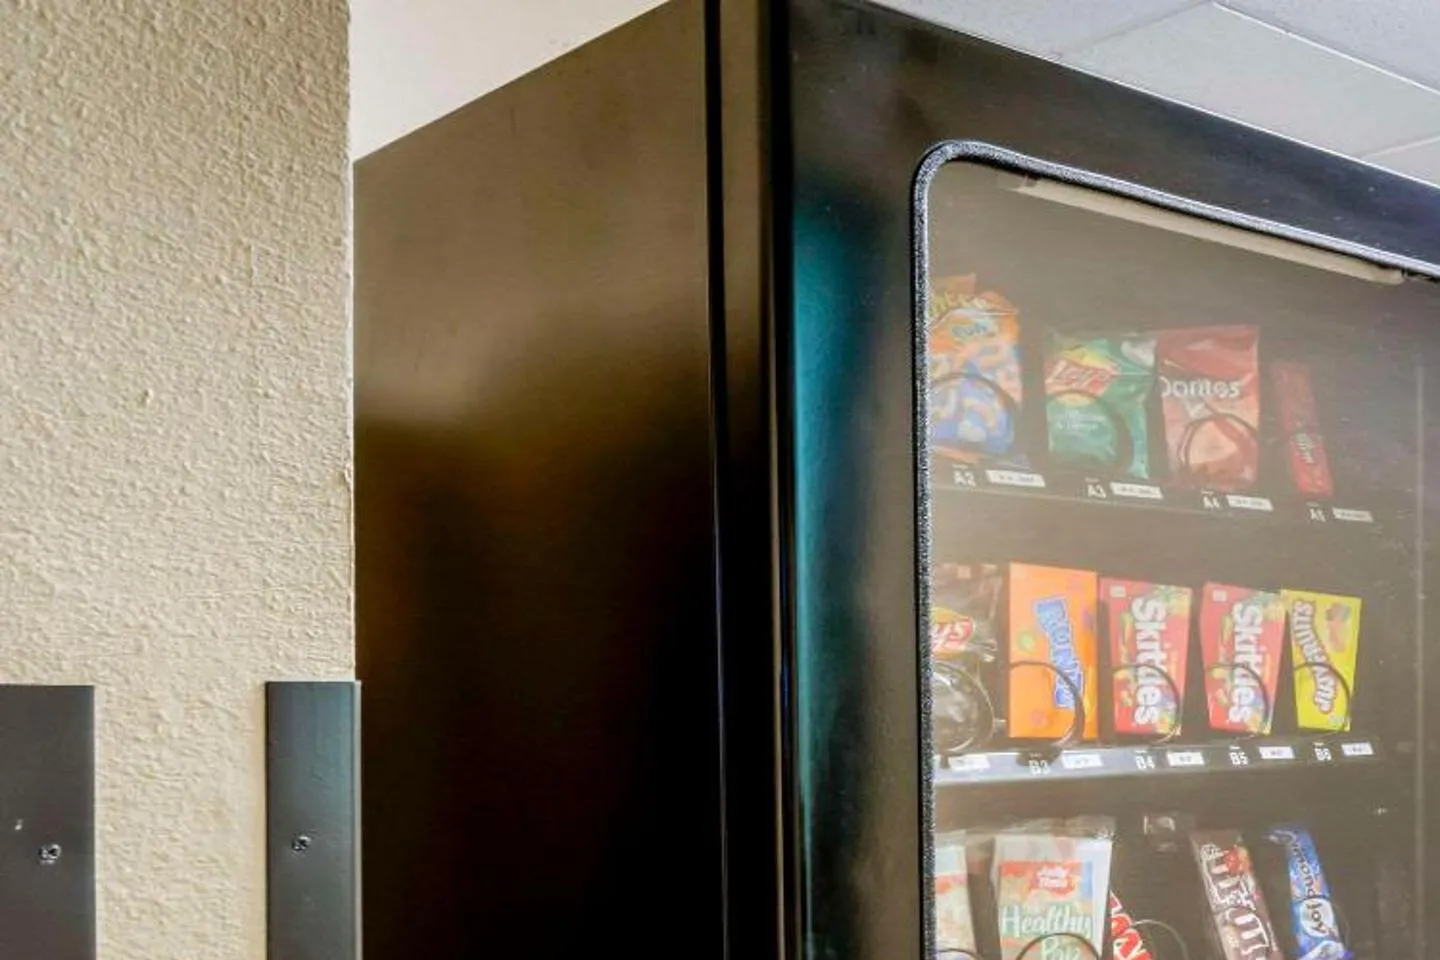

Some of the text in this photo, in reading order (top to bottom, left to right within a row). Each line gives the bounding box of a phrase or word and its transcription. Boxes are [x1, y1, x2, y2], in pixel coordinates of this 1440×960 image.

[1131, 597, 1172, 725] Skittles
[1228, 601, 1267, 722] Skittles
[1001, 904, 1094, 939] Healthy
